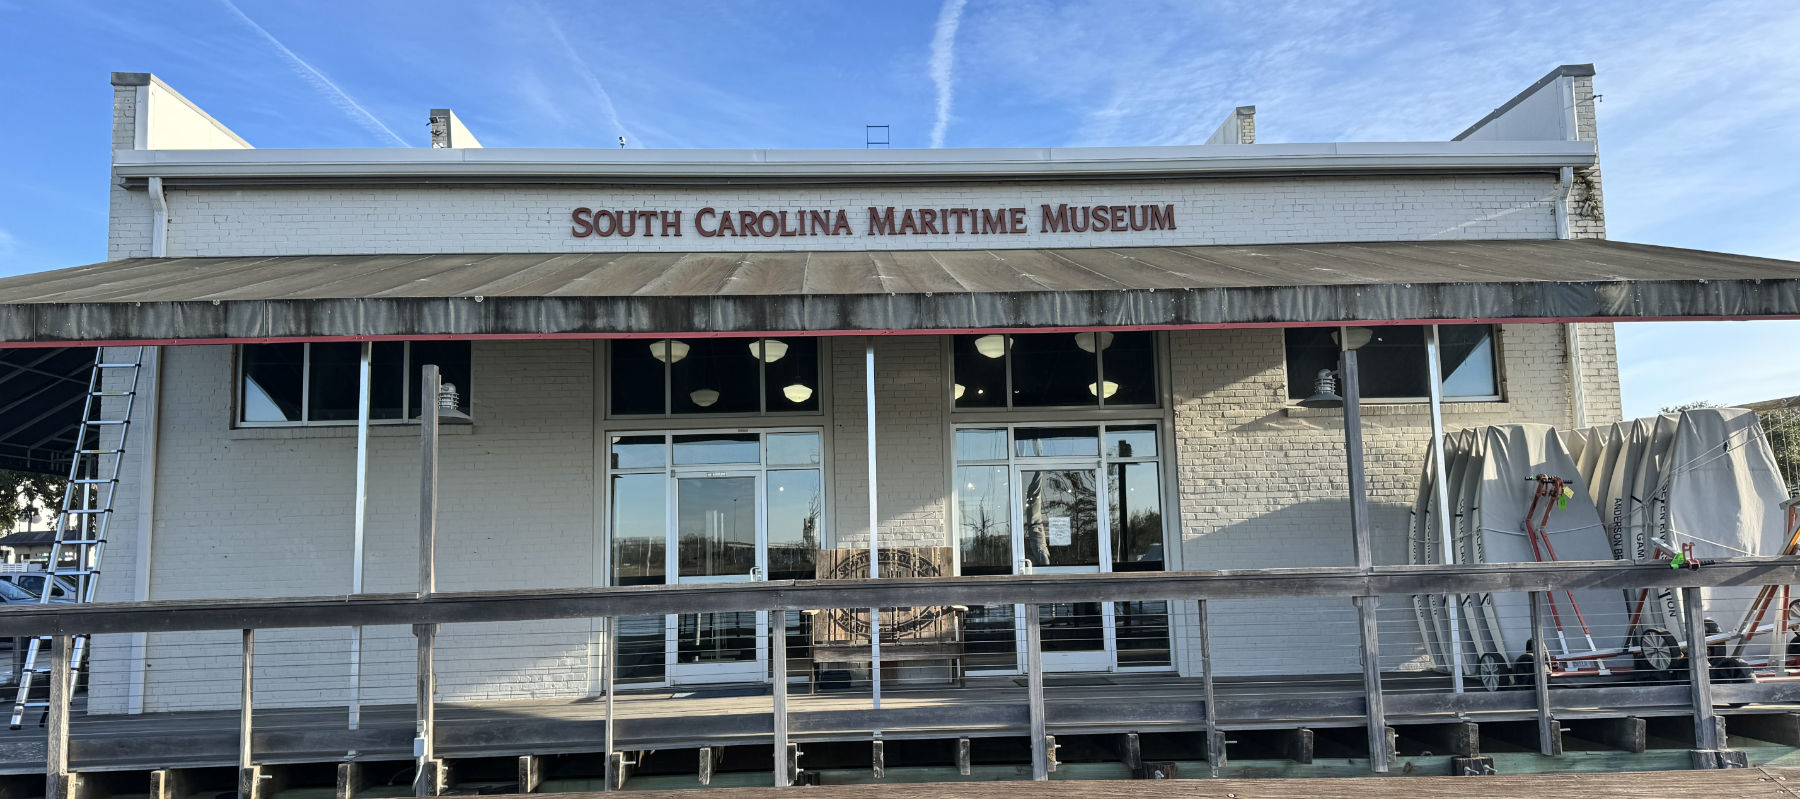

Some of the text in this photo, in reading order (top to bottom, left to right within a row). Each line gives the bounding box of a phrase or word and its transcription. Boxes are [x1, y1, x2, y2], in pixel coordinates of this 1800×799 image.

[571, 204, 1177, 238] SOUTH CAROLINA MARITIME MUSEUM
[1613, 498, 1623, 549] ANDERSON
